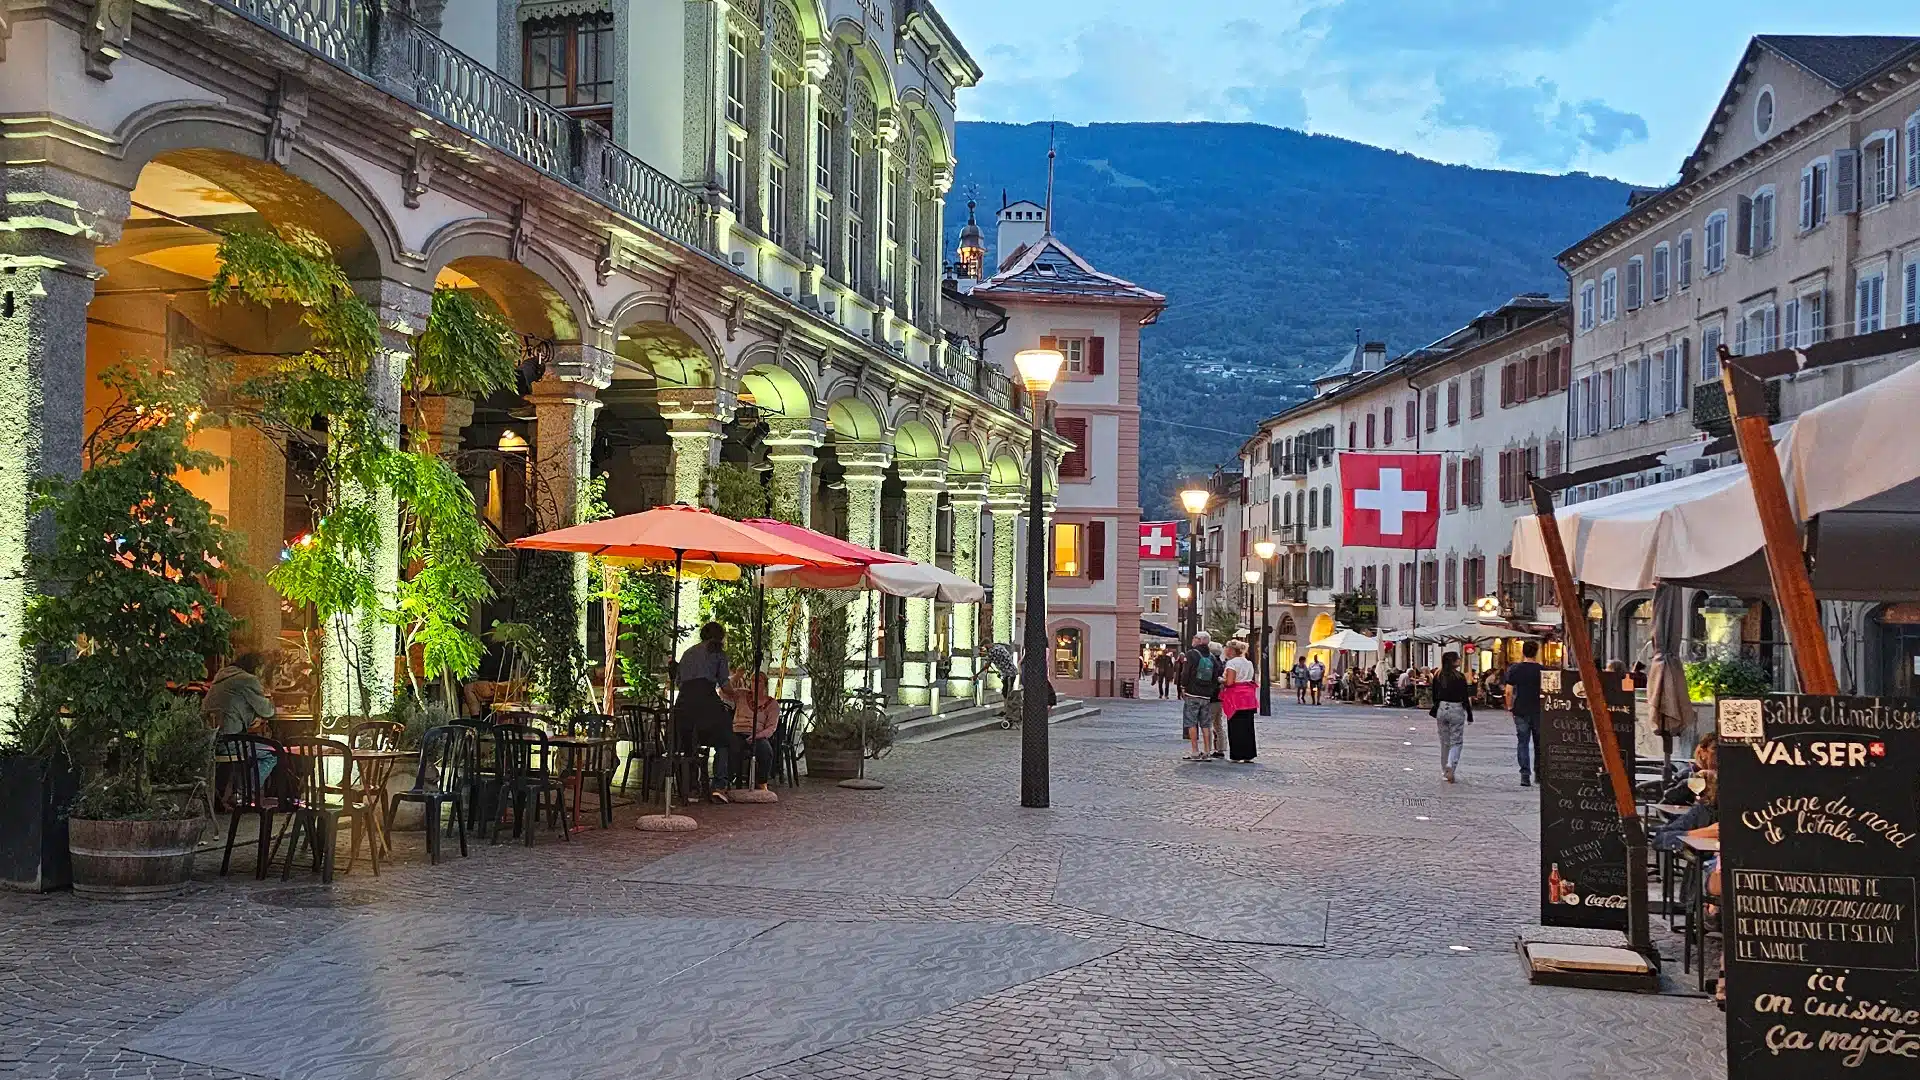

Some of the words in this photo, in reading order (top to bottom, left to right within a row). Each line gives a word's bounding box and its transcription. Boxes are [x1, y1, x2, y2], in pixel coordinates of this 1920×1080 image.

[1764, 821, 1786, 845] de
[1825, 796, 1856, 819] du
[1858, 811, 1916, 849] nord
[1828, 877, 1861, 895] PARTIR
[1866, 879, 1881, 897] DE
[1737, 894, 1788, 915] PRODUITS
[1738, 918, 1753, 936] DE
[1828, 923, 1849, 941] ET
[1851, 924, 1895, 944] SELON
[1739, 940, 1756, 959] LE
[1807, 967, 1850, 992] ici
[1754, 993, 1794, 1015] on
